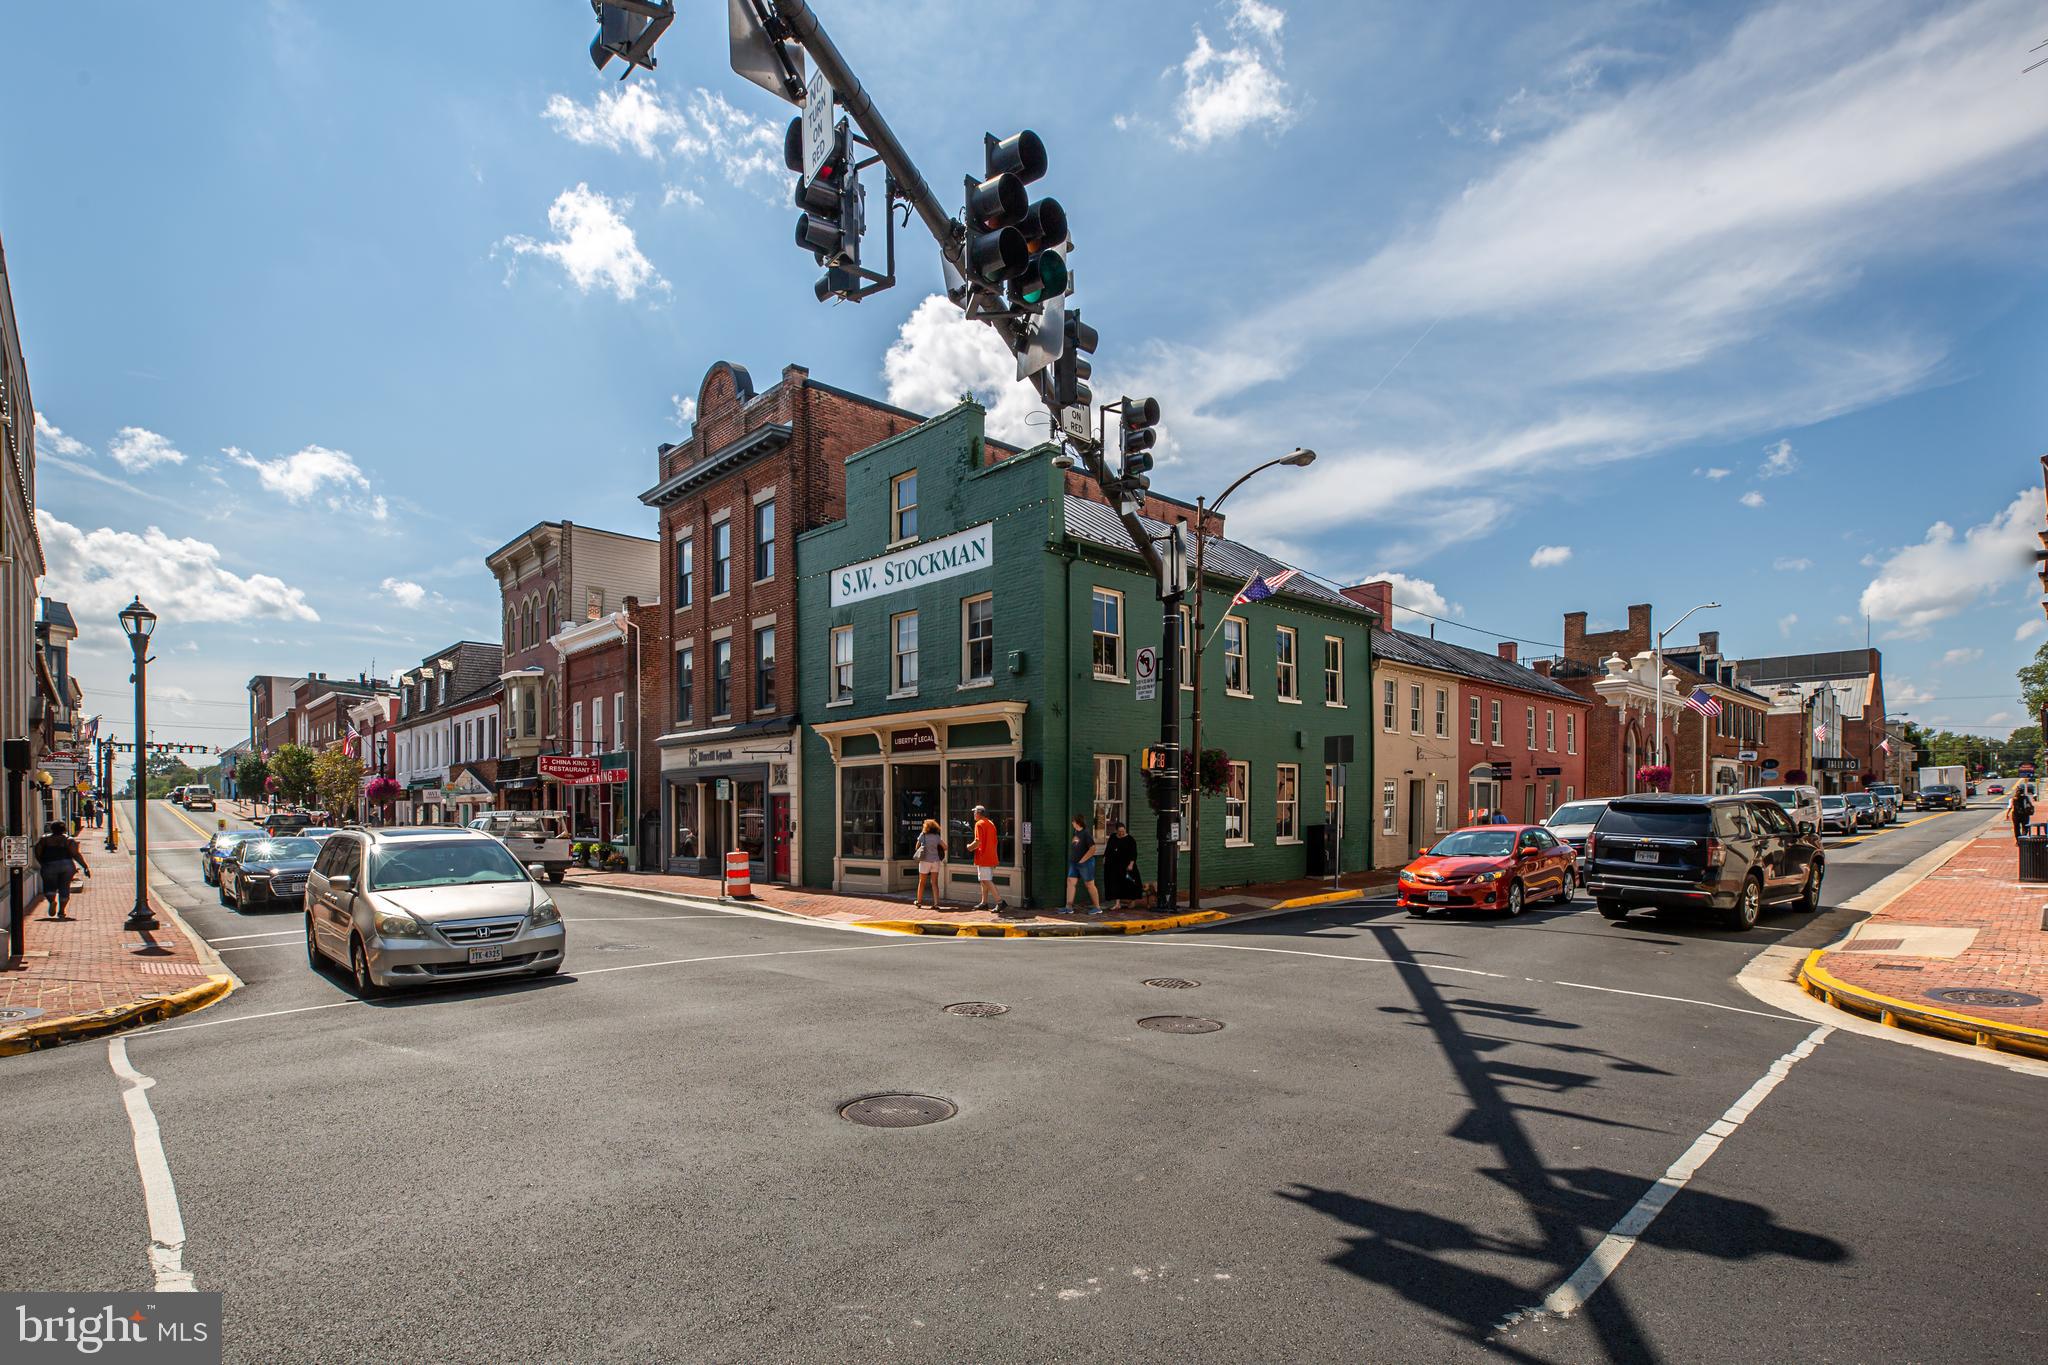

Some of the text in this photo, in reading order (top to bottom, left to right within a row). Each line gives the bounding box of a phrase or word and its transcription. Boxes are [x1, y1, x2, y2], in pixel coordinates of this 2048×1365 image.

[810, 74, 823, 106] NO
[808, 91, 827, 128] TURN
[812, 119, 823, 143] ON
[811, 139, 825, 168] RED
[1071, 410, 1082, 422] ON
[1070, 421, 1084, 434] RED
[842, 537, 986, 597] S.W. STOCKMAN
[894, 735, 934, 745] LIBERTY LEGAL
[548, 765, 590, 773] RESTAURANT
[551, 758, 572, 766] CHINA
